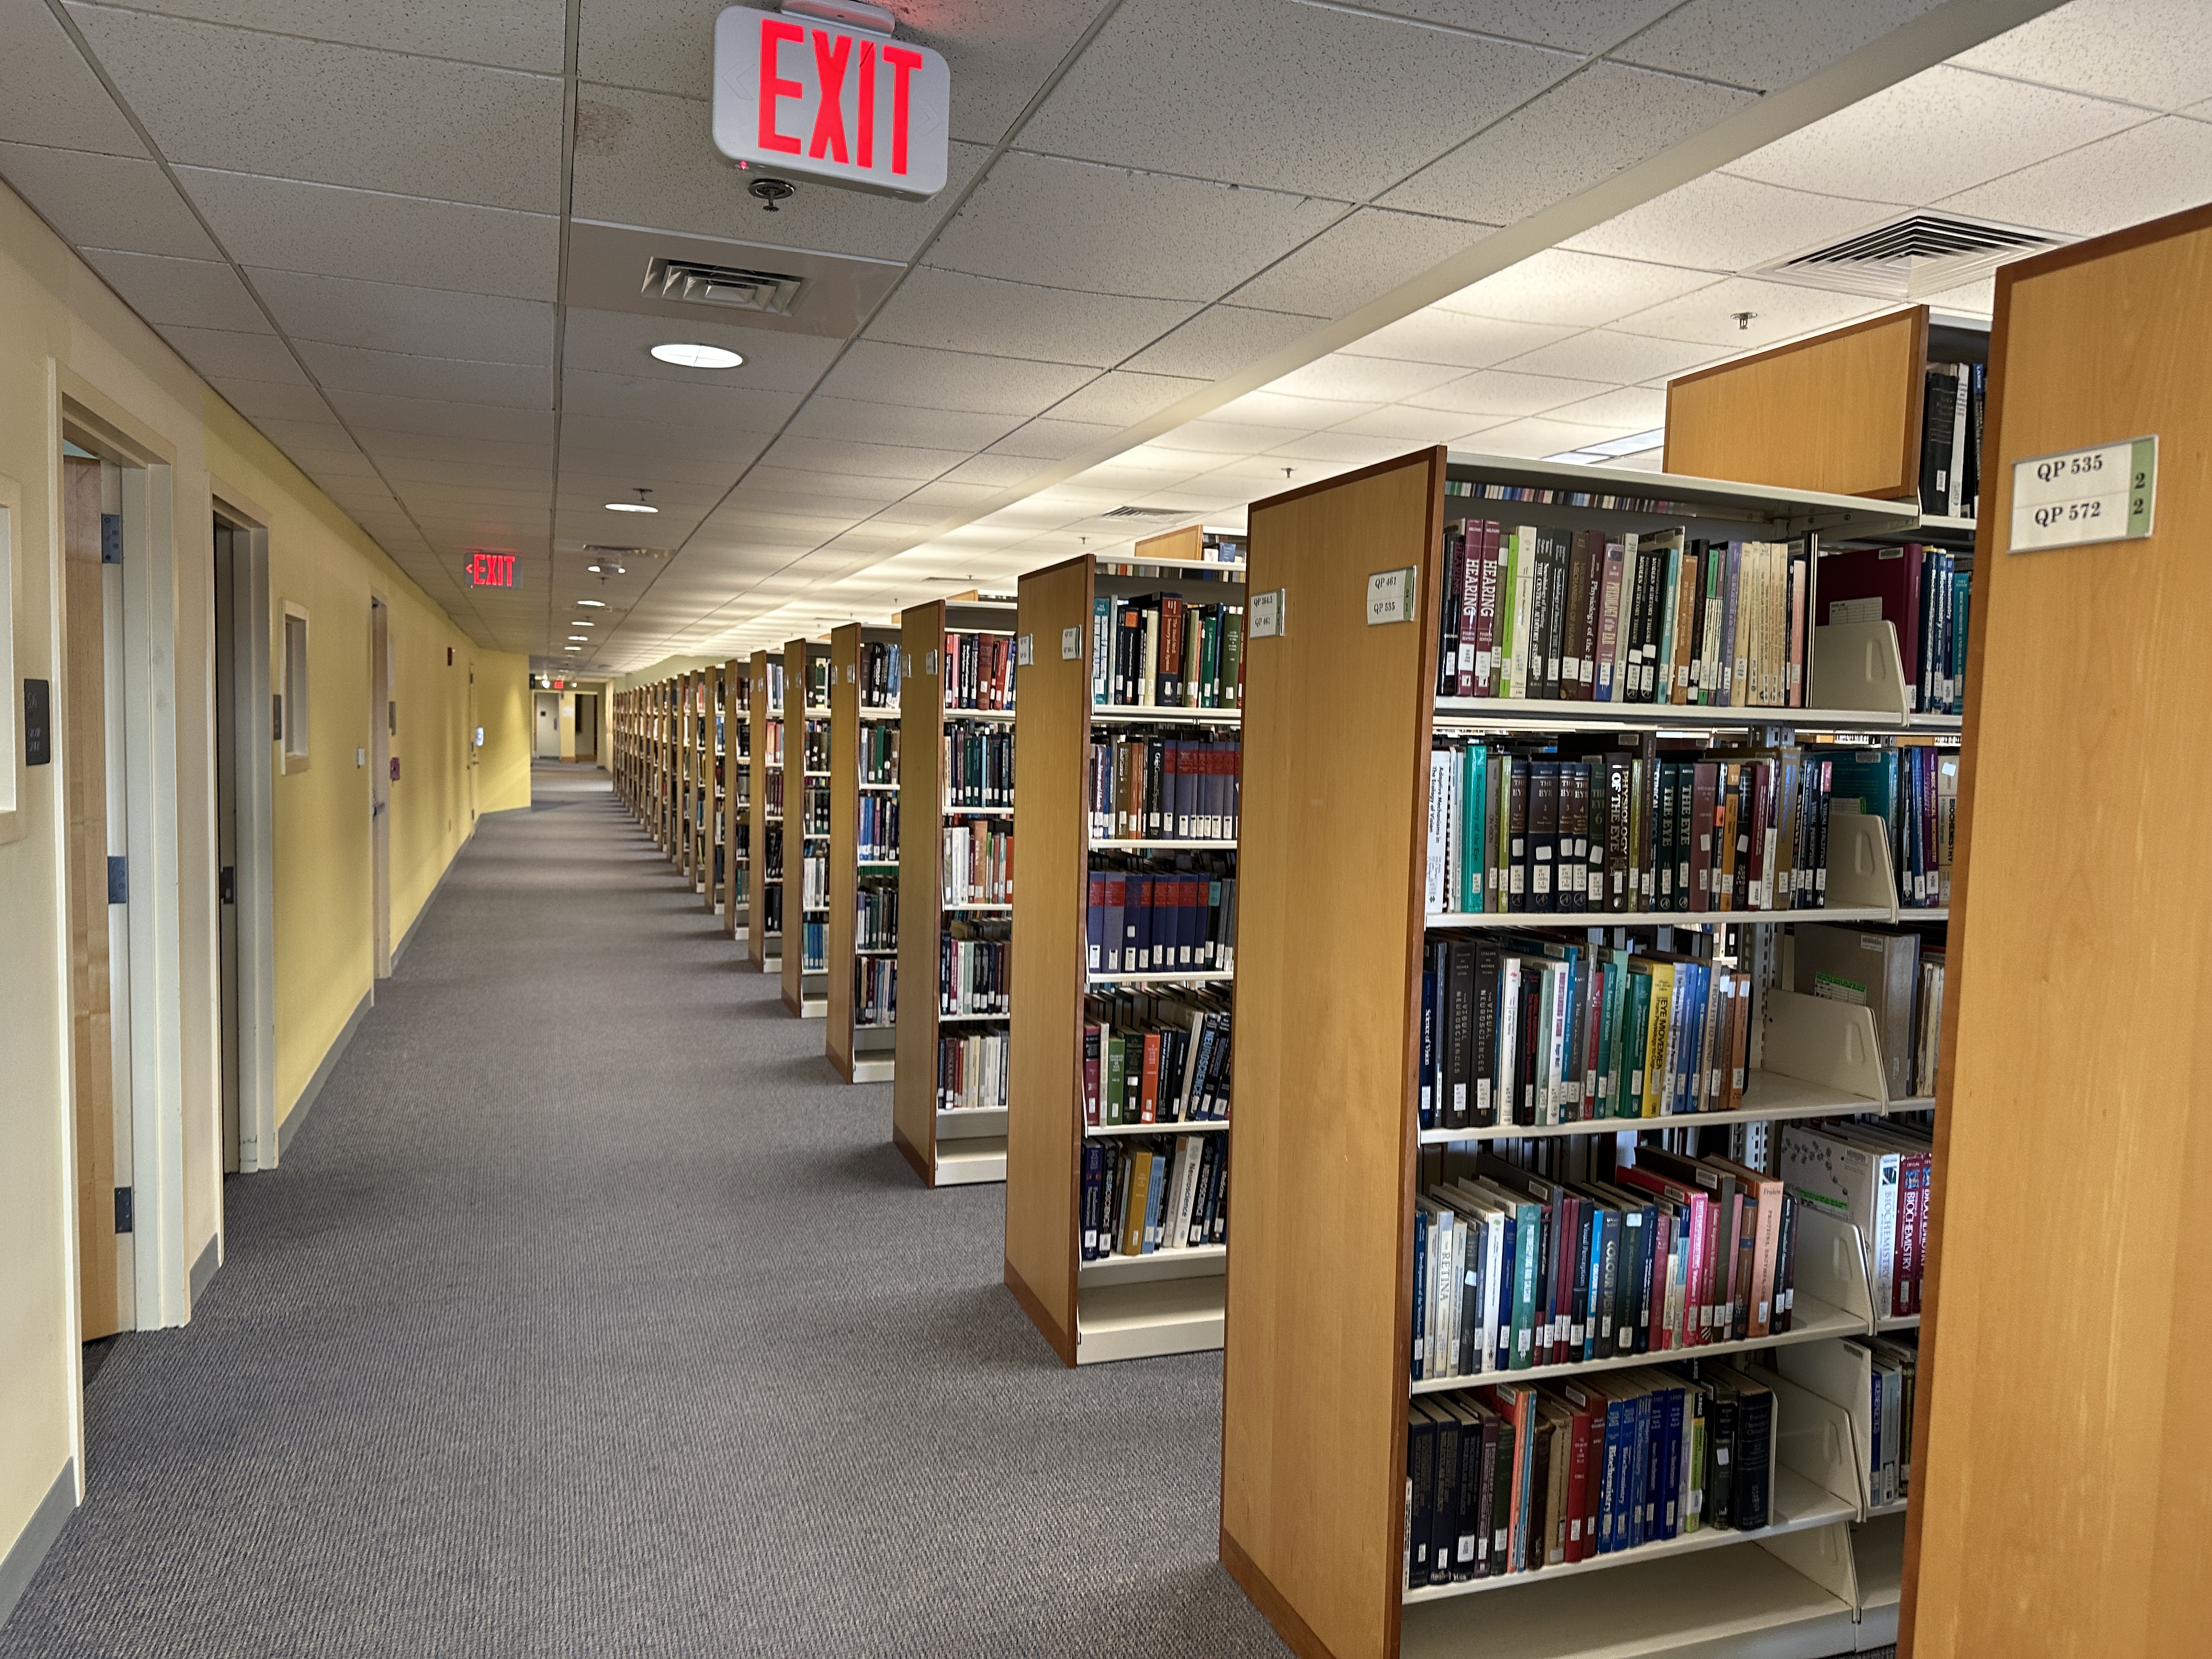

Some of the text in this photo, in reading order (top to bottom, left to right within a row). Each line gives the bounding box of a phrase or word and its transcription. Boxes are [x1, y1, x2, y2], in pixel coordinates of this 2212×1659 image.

[758, 18, 923, 175] EXIT
[2037, 455, 2103, 482] QP 535
[2134, 472, 2146, 489] 2
[2035, 501, 2101, 527] QP 572
[2132, 498, 2143, 515] 2
[474, 554, 515, 586] EXIT
[1375, 576, 1396, 589] QP 461
[1453, 541, 1463, 595] HEARING
[1463, 558, 1479, 616] HEARING
[1480, 560, 1497, 617] HEARING
[1254, 597, 1261, 608] QP
[1255, 617, 1262, 628] QP
[1374, 602, 1395, 614] QP 535
[1587, 580, 1598, 625] Physiology
[1604, 582, 1620, 618] PHYSIOLOGY
[1937, 571, 1945, 629] Biochemistry
[1587, 627, 1594, 636] of
[1601, 632, 1616, 645] EAR
[1473, 774, 1482, 820] Biochemistry
[1595, 814, 1602, 824] 6
[1610, 772, 1622, 853] OF THE EYE
[1621, 770, 1629, 855] PHYSIOLOGY
[1662, 786, 1674, 847] THE EYE
[1680, 785, 1692, 845] THE EYE
[1474, 823, 1480, 832] of
[1477, 989, 1486, 1072] NEUROSCIENCES
[1657, 999, 1668, 1069] EYE MOVEMEN
[1708, 1025, 1715, 1037] TO
[1193, 1030, 1215, 1096] NEUROSCIENCE
[1182, 1163, 1195, 1217] Neuroscience
[1882, 1190, 1892, 1279] BIOCHEMISTRY
[1901, 1191, 1916, 1272] BIOCHEMISTRY
[1440, 1252, 1451, 1301] RETINA
[1579, 1245, 1588, 1286] Perception
[1604, 1240, 1616, 1288] COLOUR
